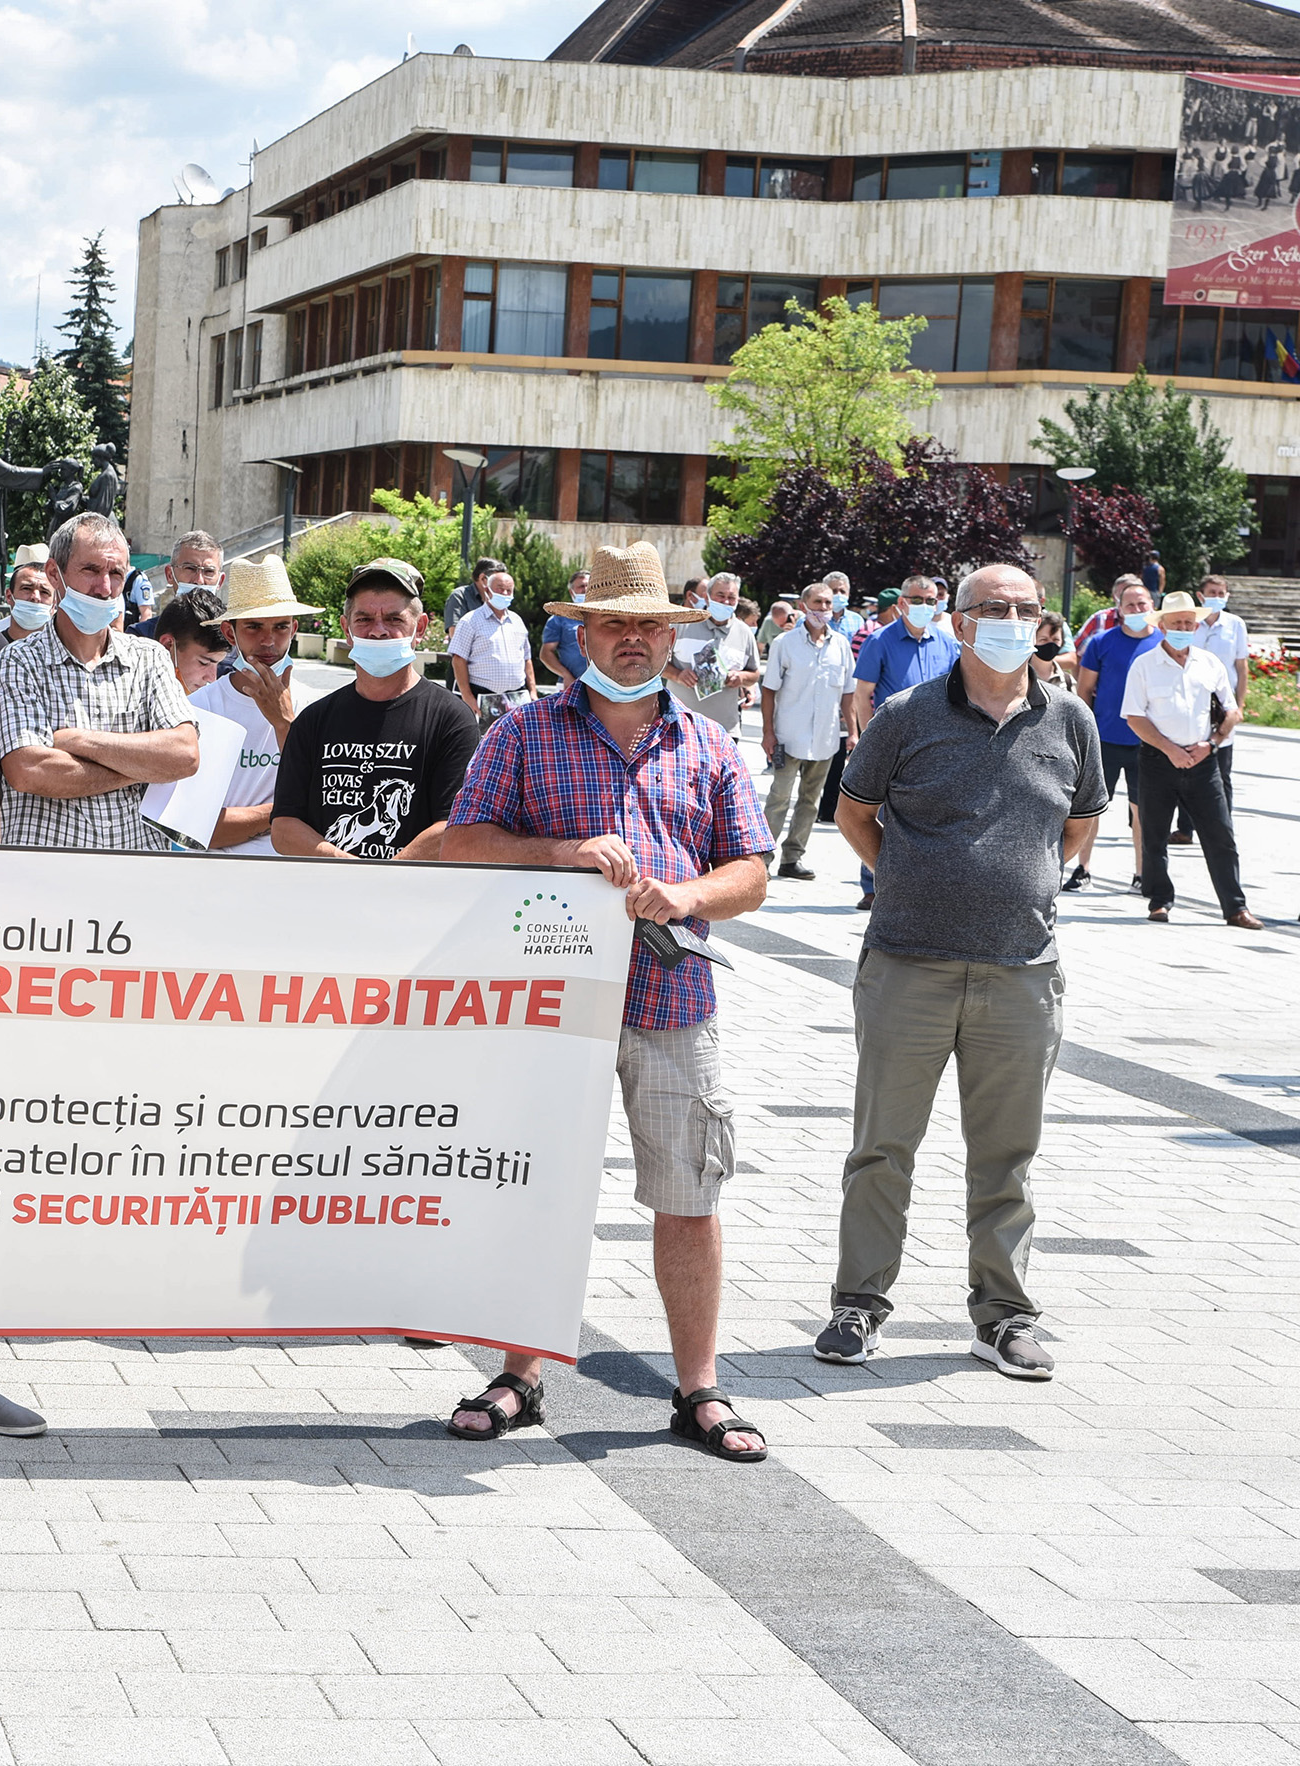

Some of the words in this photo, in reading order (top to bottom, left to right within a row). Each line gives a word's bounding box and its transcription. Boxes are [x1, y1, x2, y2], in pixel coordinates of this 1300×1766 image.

[1185, 224, 1227, 248] 1931
[321, 743, 375, 759] LOVAS
[375, 740, 417, 760] SZÍV
[360, 760, 375, 773] ÉS
[86, 919, 132, 955] 16
[525, 934, 589, 944] JUDEȚEAN
[526, 923, 589, 933] CONSILIUL
[523, 944, 593, 955] HARGHITA
[258, 975, 566, 1028] HABITATE
[174, 1094, 206, 1135] și
[217, 1103, 459, 1129] conservarea
[130, 1143, 165, 1177] în
[179, 1144, 352, 1177] interesul
[361, 1144, 532, 1190] sănătății
[12, 1186, 262, 1235] SECURITĂȚII
[271, 1195, 451, 1227] PUBLICE.
